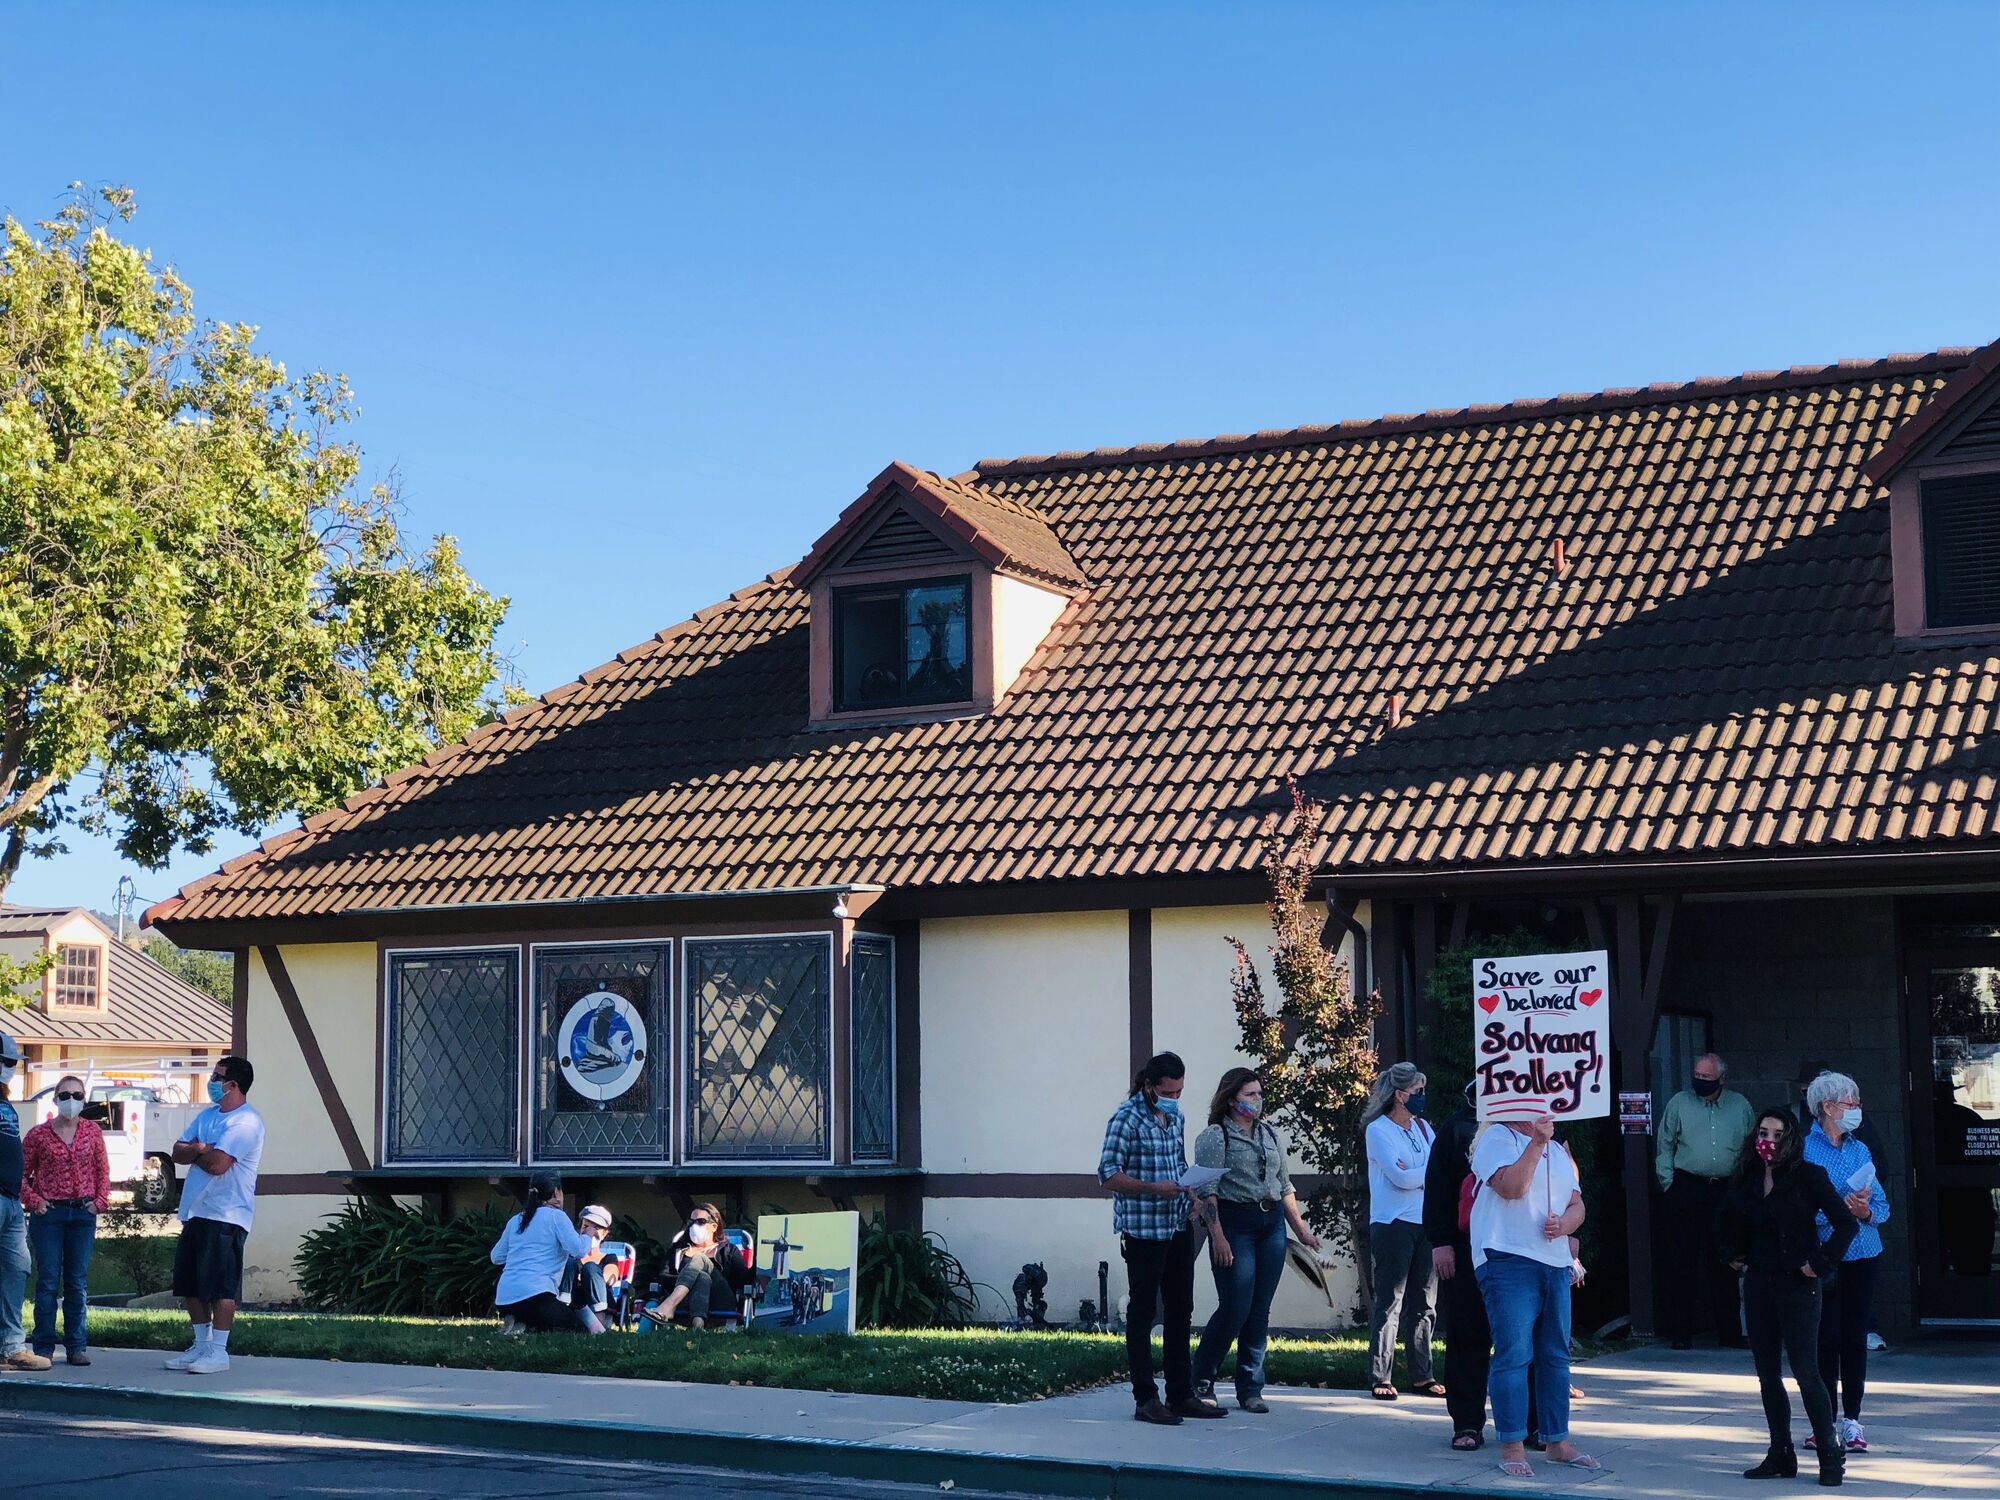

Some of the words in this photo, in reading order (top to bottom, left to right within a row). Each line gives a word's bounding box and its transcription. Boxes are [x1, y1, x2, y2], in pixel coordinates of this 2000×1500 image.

[1479, 961, 1544, 989] Save
[1554, 965, 1596, 984] our
[1503, 985, 1578, 1011] beloved
[1480, 1016, 1598, 1072] Solvang
[1477, 1052, 1603, 1114] Trolley!
